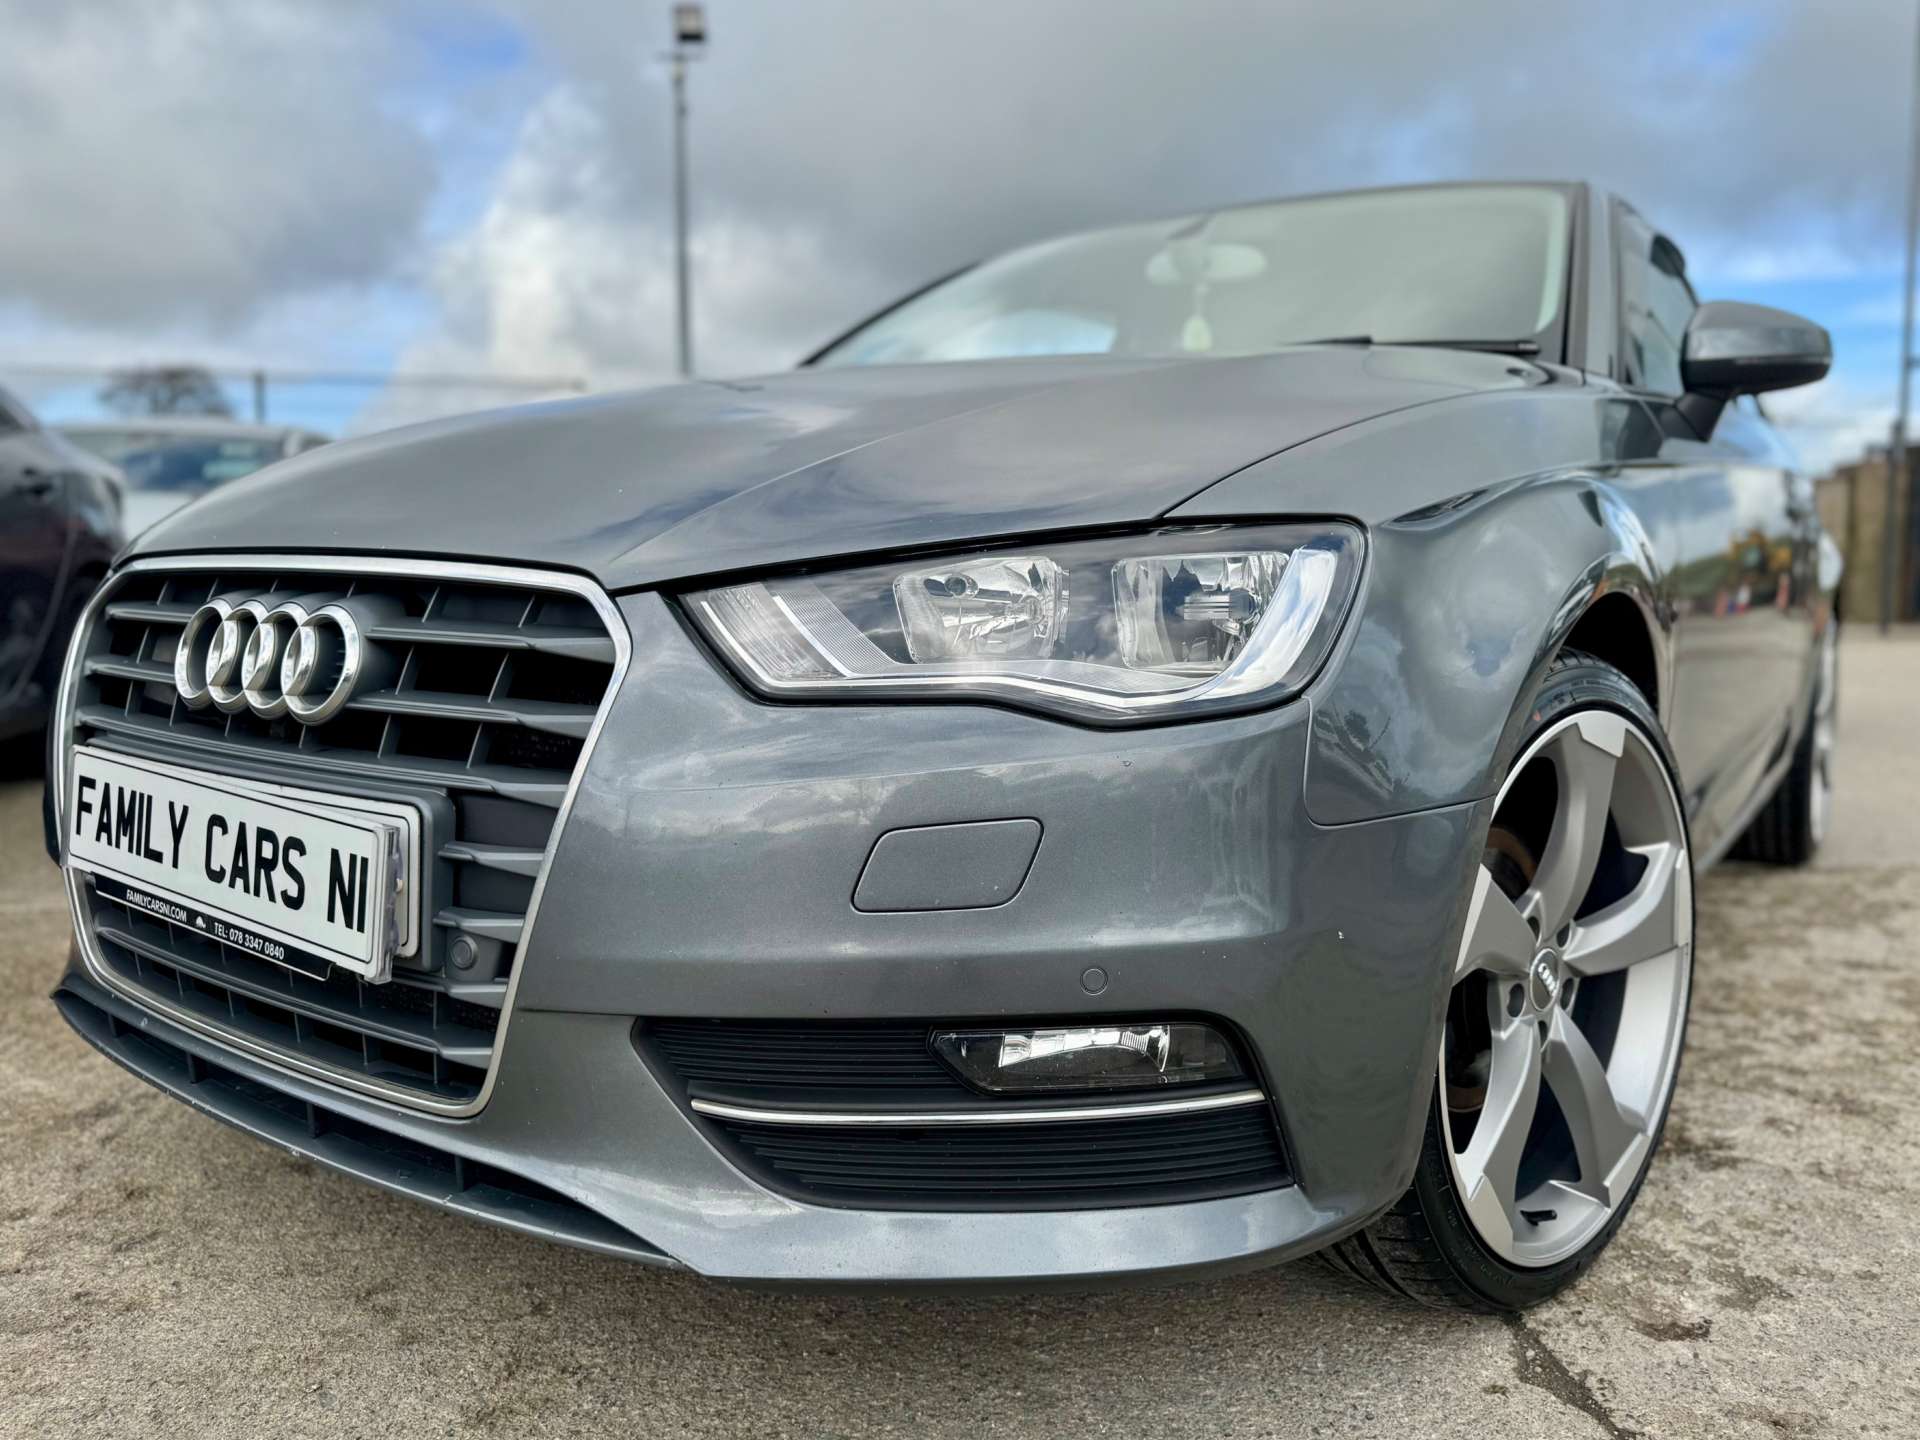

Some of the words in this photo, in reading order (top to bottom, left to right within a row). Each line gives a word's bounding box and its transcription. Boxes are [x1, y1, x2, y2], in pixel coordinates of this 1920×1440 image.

[75, 775, 189, 869] FAMILY
[204, 814, 307, 910] CARS
[327, 848, 369, 933] NI
[126, 889, 187, 923] FAMILYCARSNI.COM
[214, 922, 228, 938] TEL:
[229, 928, 244, 944] 078
[244, 934, 263, 951] 3347
[264, 942, 284, 960] 0840
